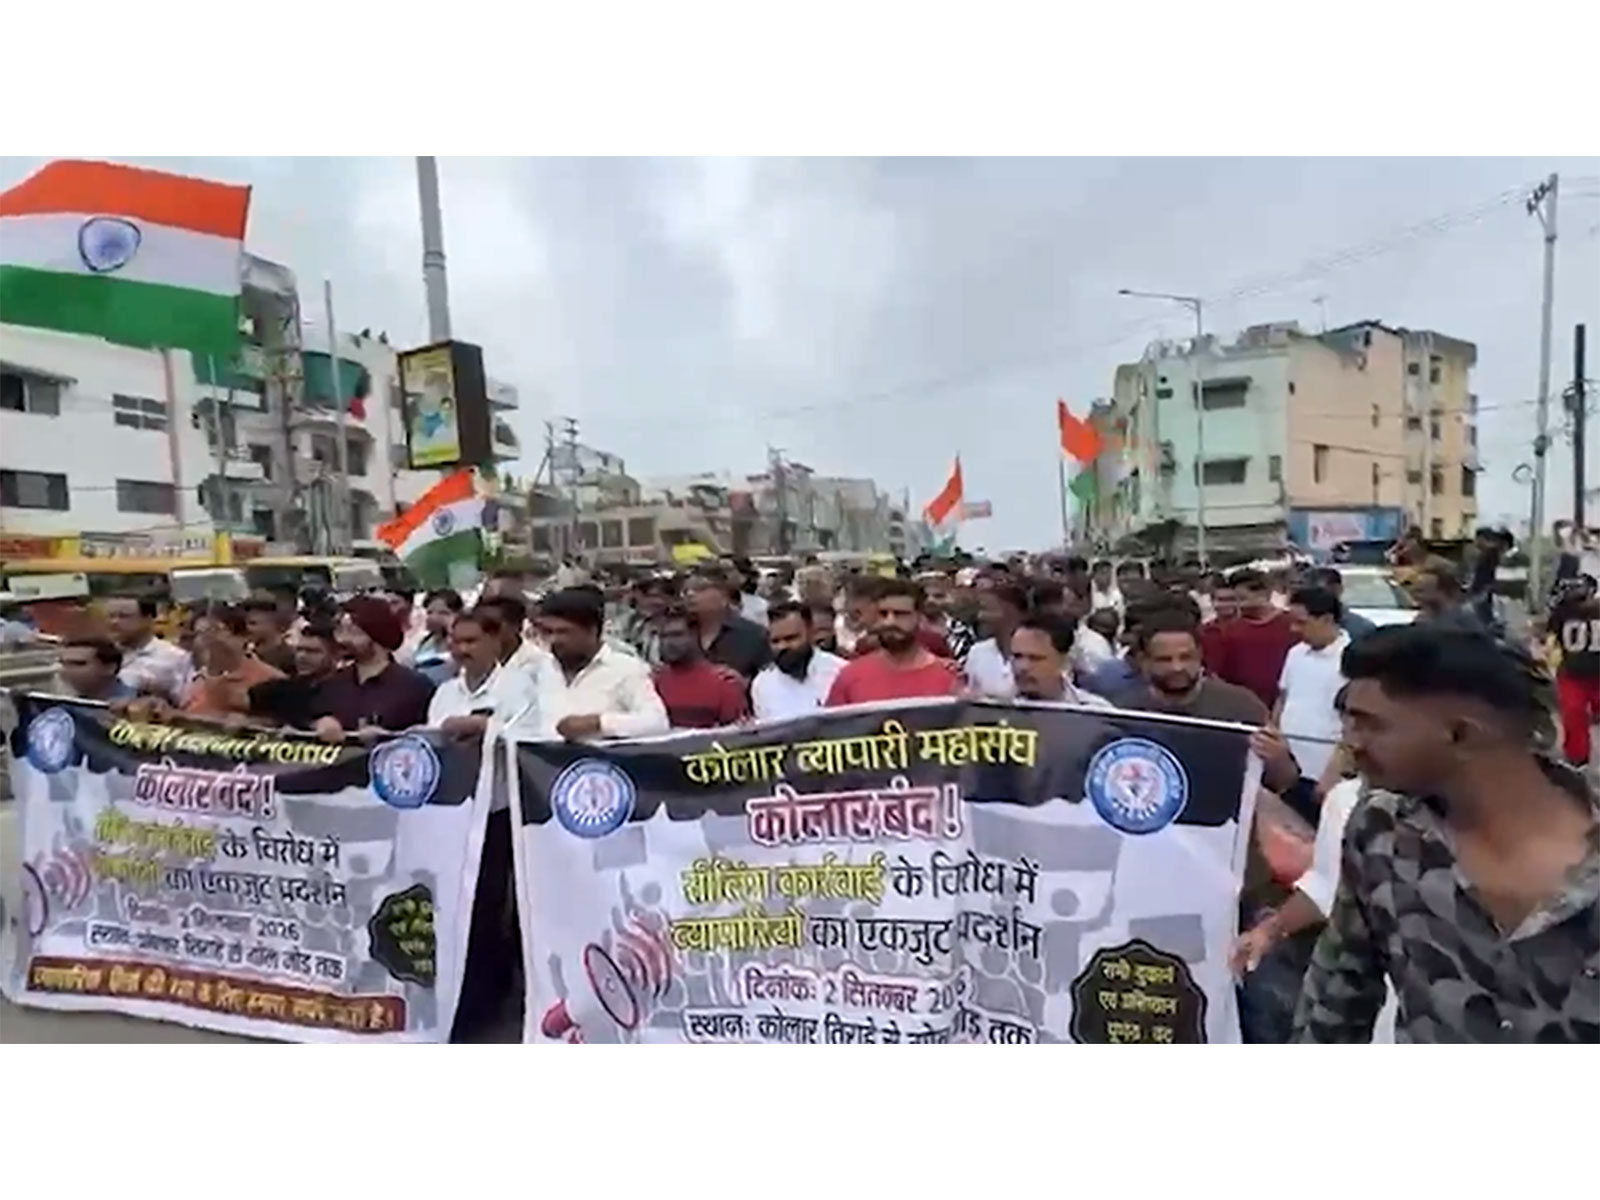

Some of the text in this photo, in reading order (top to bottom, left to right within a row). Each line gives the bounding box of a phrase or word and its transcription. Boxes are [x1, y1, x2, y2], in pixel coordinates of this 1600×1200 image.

[682, 740, 789, 785] कोलार
[793, 718, 909, 776] व्यापारी
[915, 719, 1039, 768] महासंघ
[746, 781, 878, 847] कोलार
[221, 828, 249, 858] के
[252, 826, 316, 866] विरोध
[318, 834, 342, 868] में
[200, 868, 275, 906] एकजुट
[776, 851, 888, 907] कार्रवाई
[890, 855, 924, 898] के
[931, 849, 1005, 899] विरोध
[1012, 856, 1040, 904] में
[810, 916, 849, 949] का
[856, 917, 953, 965] एकजुट
[825, 980, 837, 1005] 2
[756, 1005, 819, 1044] कोलार
